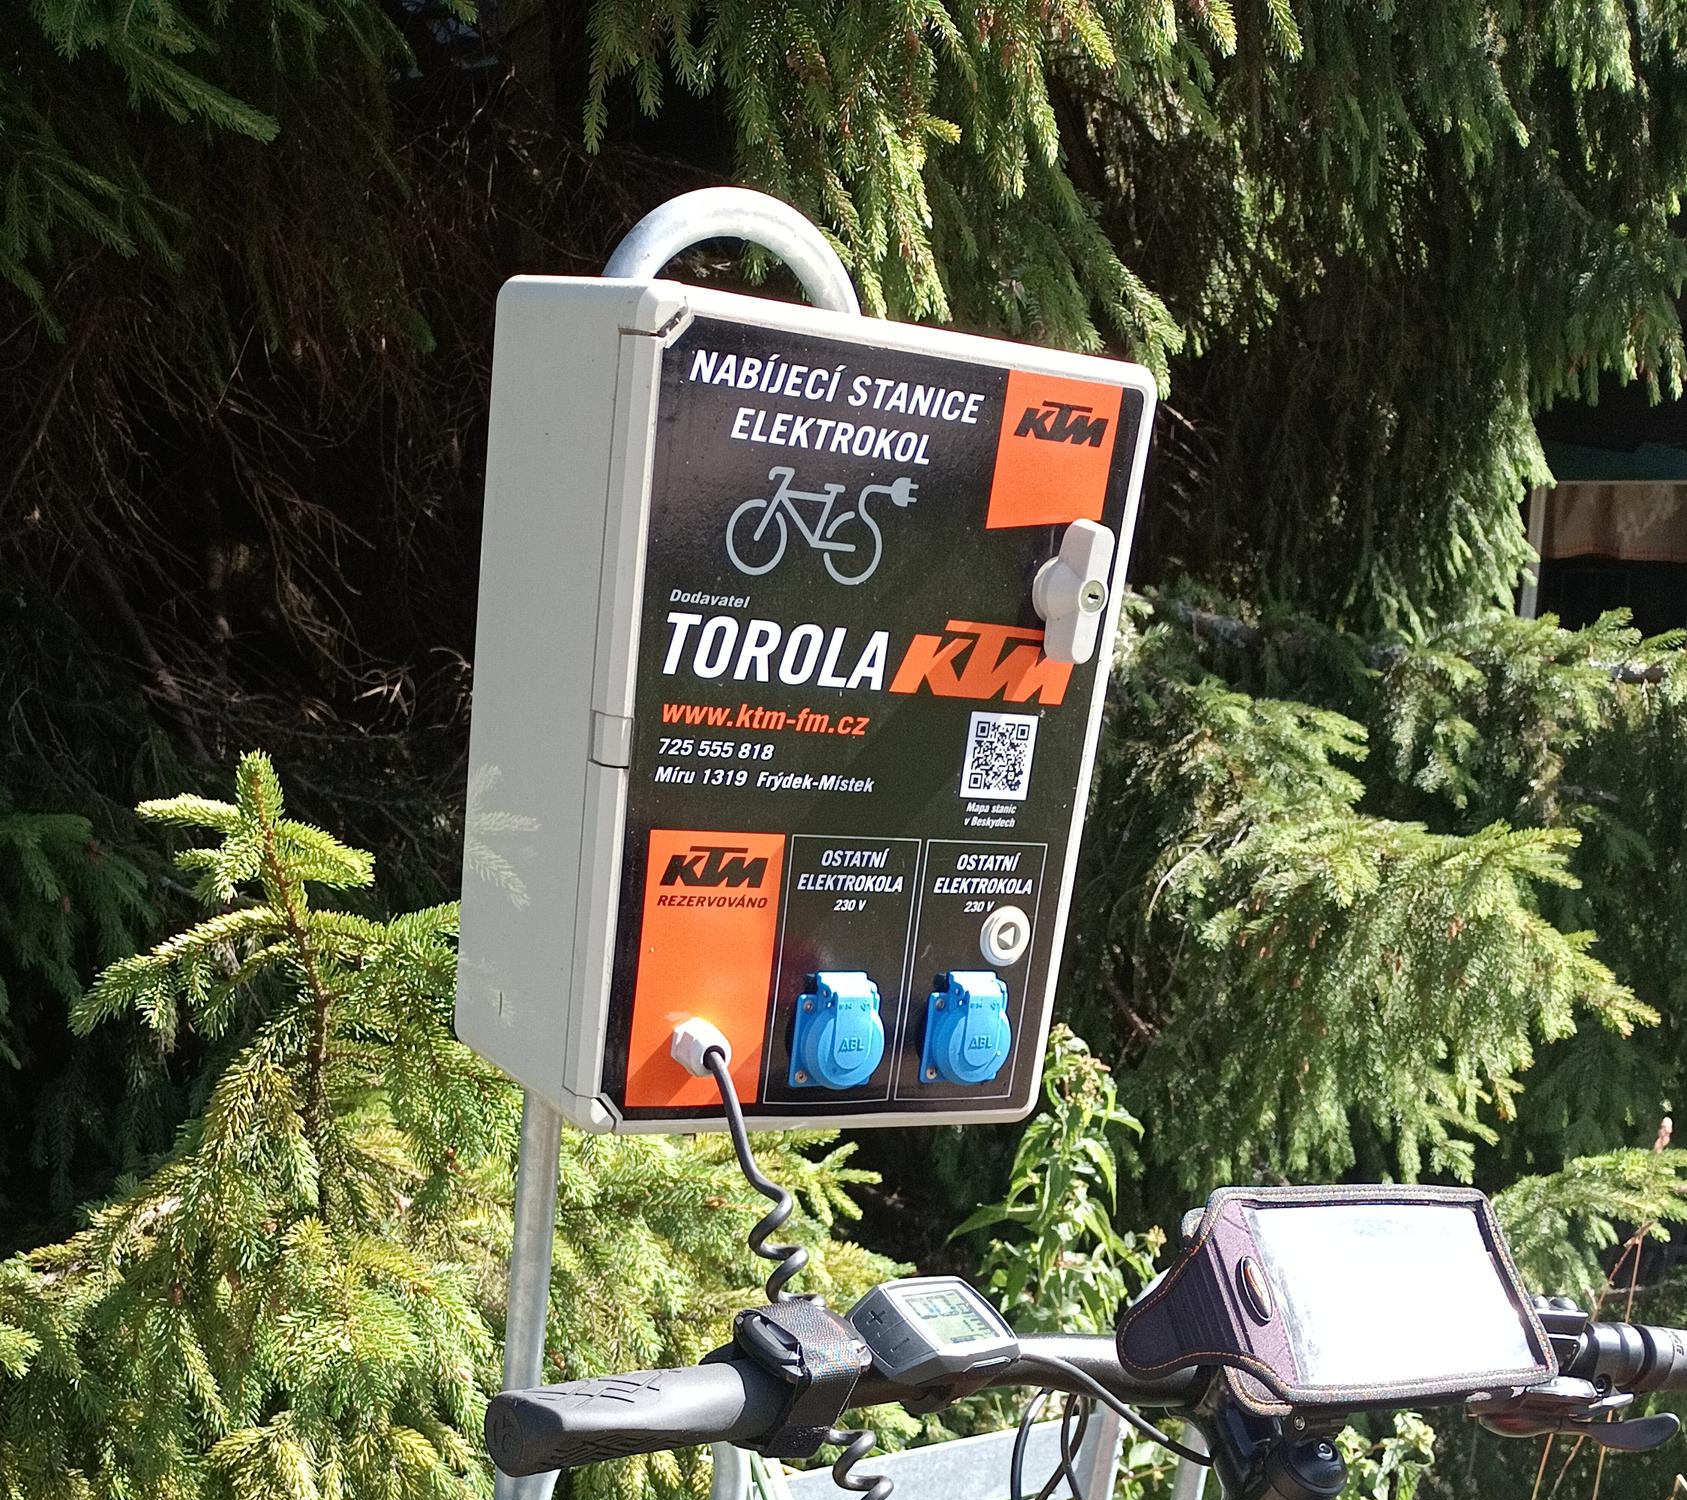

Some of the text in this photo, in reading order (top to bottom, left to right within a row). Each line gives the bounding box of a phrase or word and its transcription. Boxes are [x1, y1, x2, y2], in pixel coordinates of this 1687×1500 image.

[689, 349, 985, 424] NABÍJECÍ STANICE
[1014, 400, 1109, 448] KTM
[730, 407, 930, 465] ELEKTROKOL
[669, 589, 750, 609] Dodavatel
[662, 611, 1074, 705] TOROLA KTM
[661, 703, 870, 736] www.ktm-fm.cz
[658, 738, 775, 760] 725 555 818
[654, 766, 875, 793] Míru 1319 Frýdek-Místek
[966, 802, 1017, 814] Mapa stanic
[964, 816, 1016, 829] v Beskydech
[659, 846, 769, 889] KTM
[821, 848, 890, 868] OSTATNÍ
[956, 852, 1021, 872] OSTATNÍ
[797, 873, 903, 893] ELEKTROKOLA
[933, 877, 1033, 895] ELEKTROKOLA
[657, 894, 768, 909] REZERVOVÁNO
[833, 899, 867, 911] 230 V
[963, 901, 995, 913] 230 V
[838, 1036, 865, 1053] ABL
[967, 1034, 993, 1050] ABL
